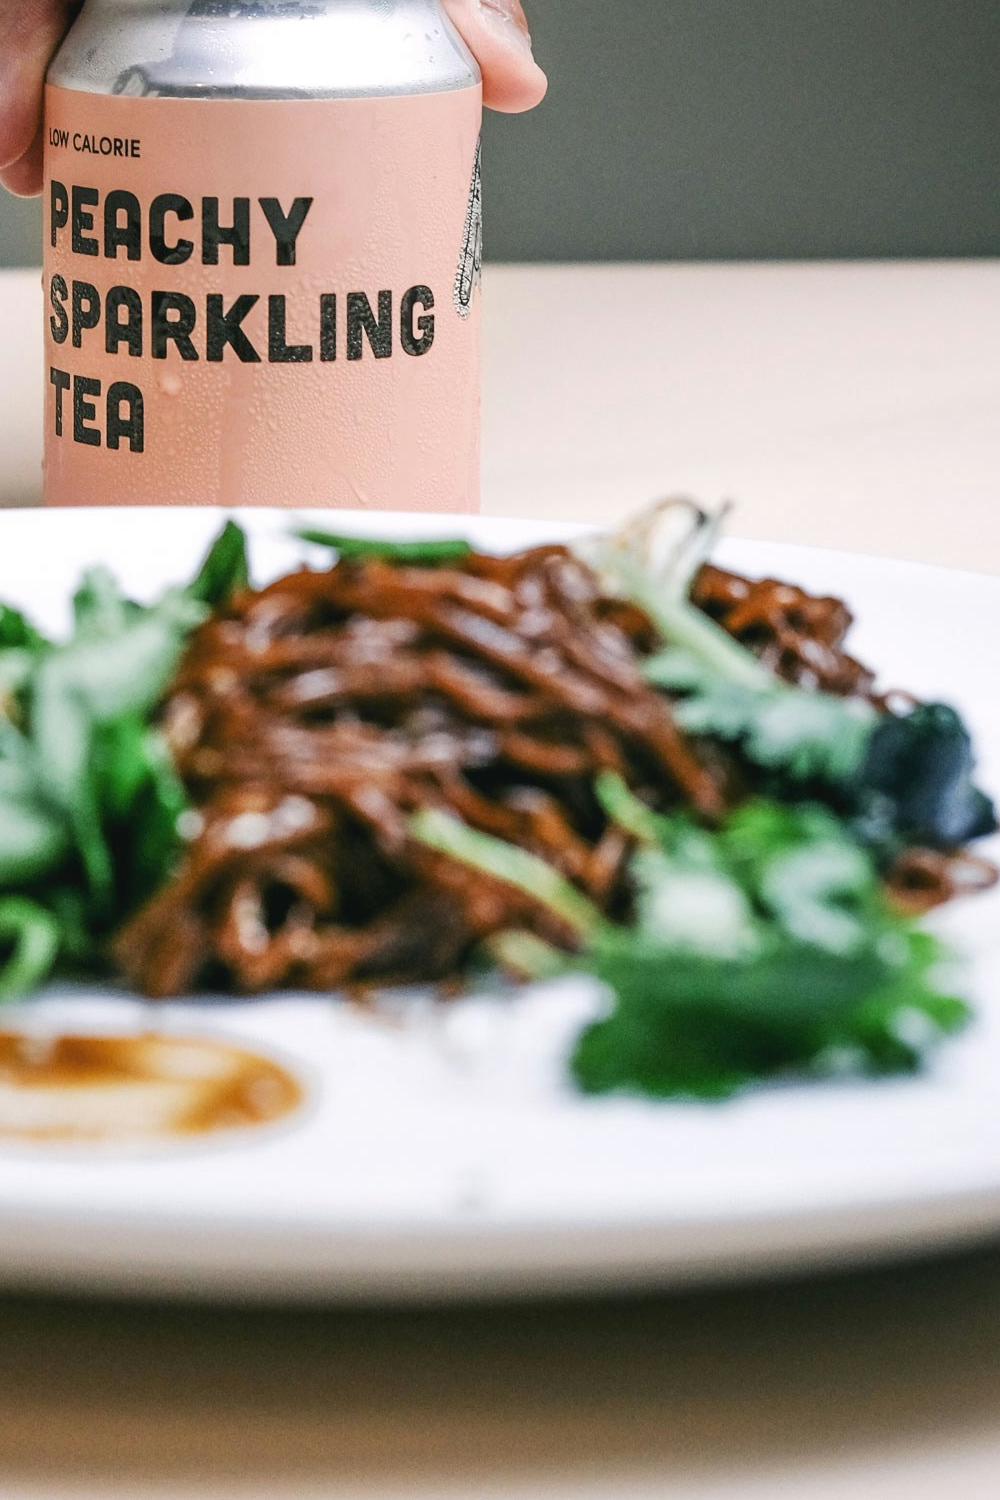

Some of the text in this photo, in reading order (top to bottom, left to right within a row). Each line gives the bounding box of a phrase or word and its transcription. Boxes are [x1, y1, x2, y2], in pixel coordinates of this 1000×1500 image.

[49, 127, 141, 158] LOW CALORIE
[50, 179, 314, 267] PEACHY
[50, 273, 435, 363] SPARKLING
[50, 366, 145, 453] TEA
